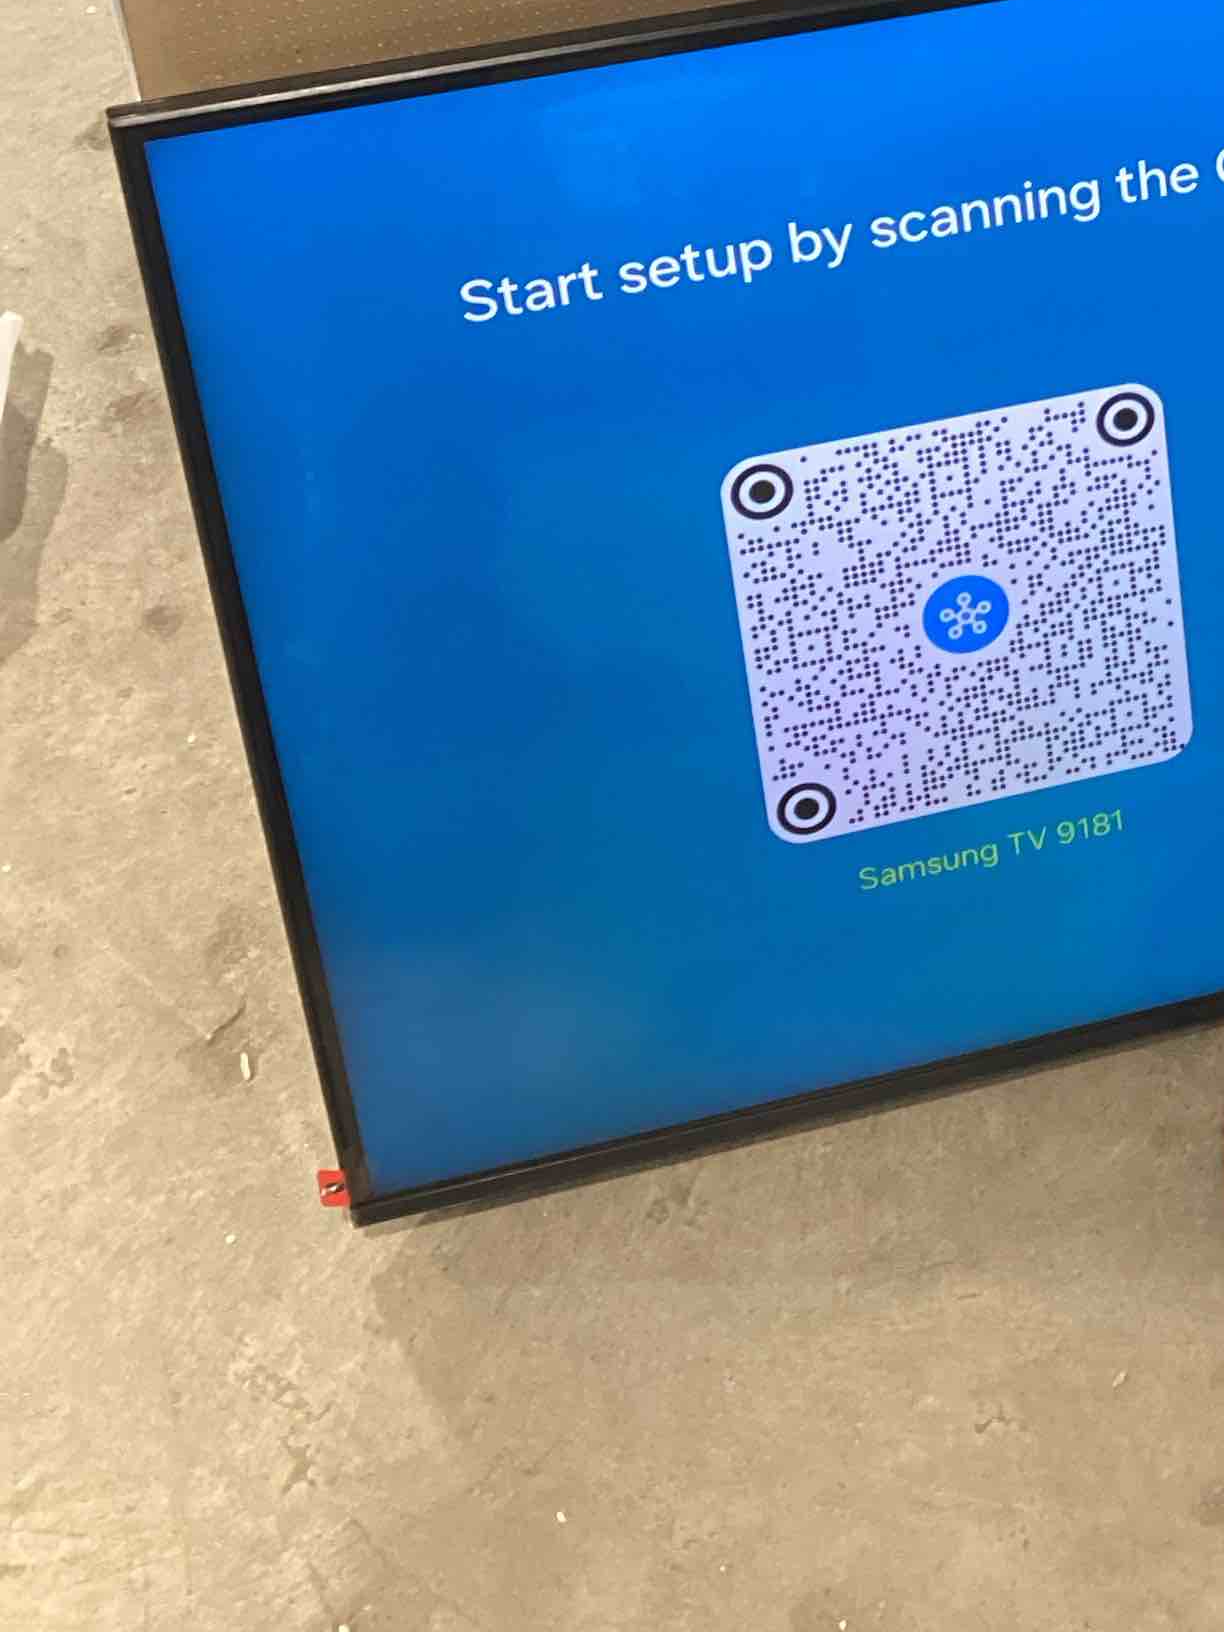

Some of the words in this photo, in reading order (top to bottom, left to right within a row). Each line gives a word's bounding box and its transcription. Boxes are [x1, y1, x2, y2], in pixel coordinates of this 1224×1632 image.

[460, 262, 604, 322] Start
[618, 239, 773, 294] setup
[787, 221, 853, 269] by
[869, 178, 1101, 248] scanning
[1114, 158, 1200, 205] the
[858, 842, 1000, 891] Samsung
[1007, 825, 1048, 857] TV
[1056, 808, 1124, 846] 9181
